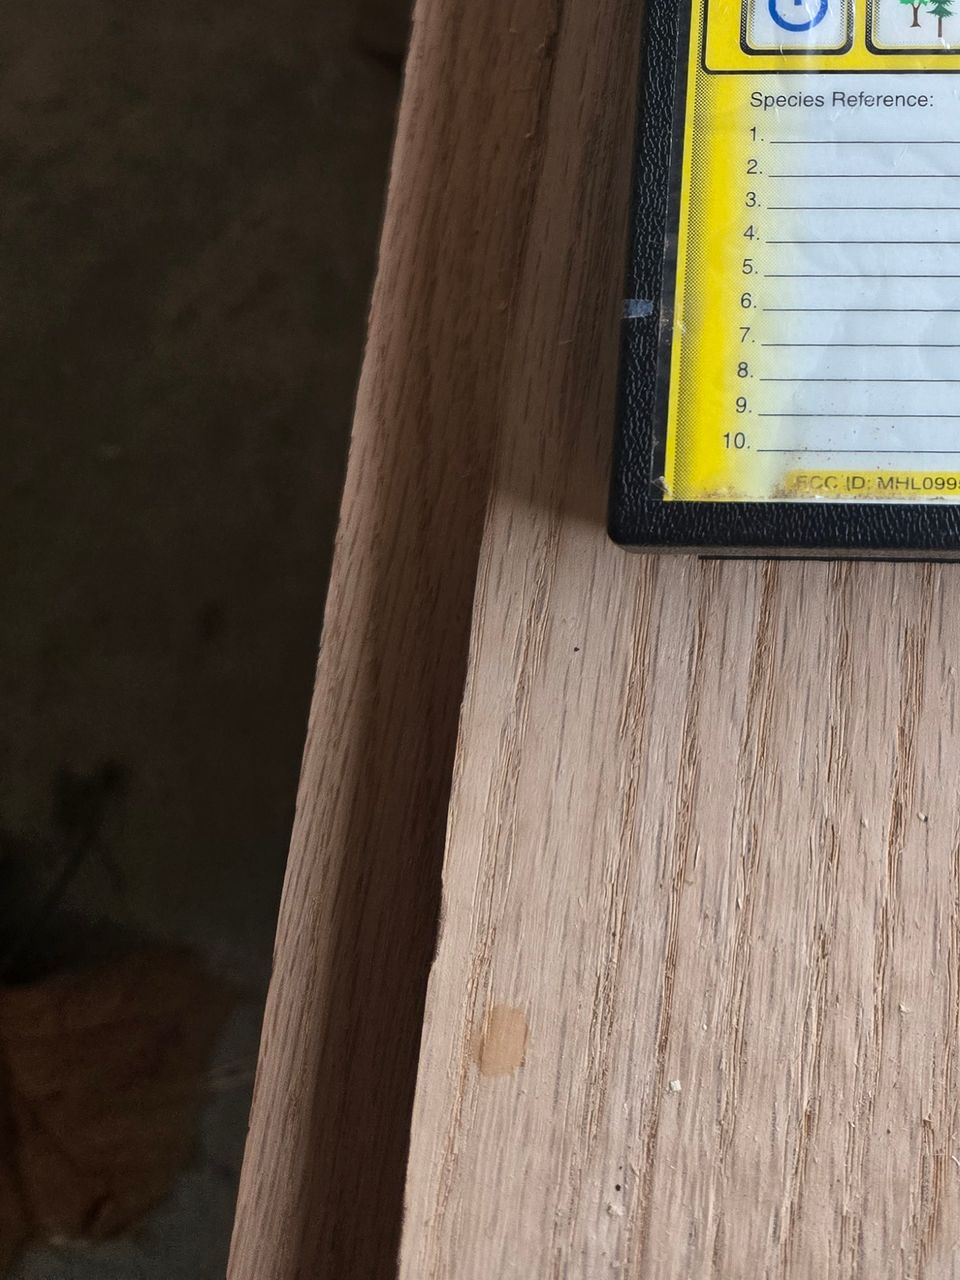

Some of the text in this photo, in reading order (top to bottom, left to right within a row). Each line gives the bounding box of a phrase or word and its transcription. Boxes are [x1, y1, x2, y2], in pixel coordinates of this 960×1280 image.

[749, 90, 934, 112] Species Reference:
[749, 126, 764, 143] 1.
[746, 158, 763, 175] 2.
[745, 191, 761, 208] 3.
[743, 224, 760, 241] 4.
[741, 258, 759, 275] 5.
[740, 292, 757, 309] 6.
[738, 326, 756, 344] 7.
[736, 361, 753, 378] 8.
[735, 396, 752, 414] 9.
[723, 431, 751, 449] 10.
[794, 475, 838, 491] FCC
[846, 475, 872, 491] ID:
